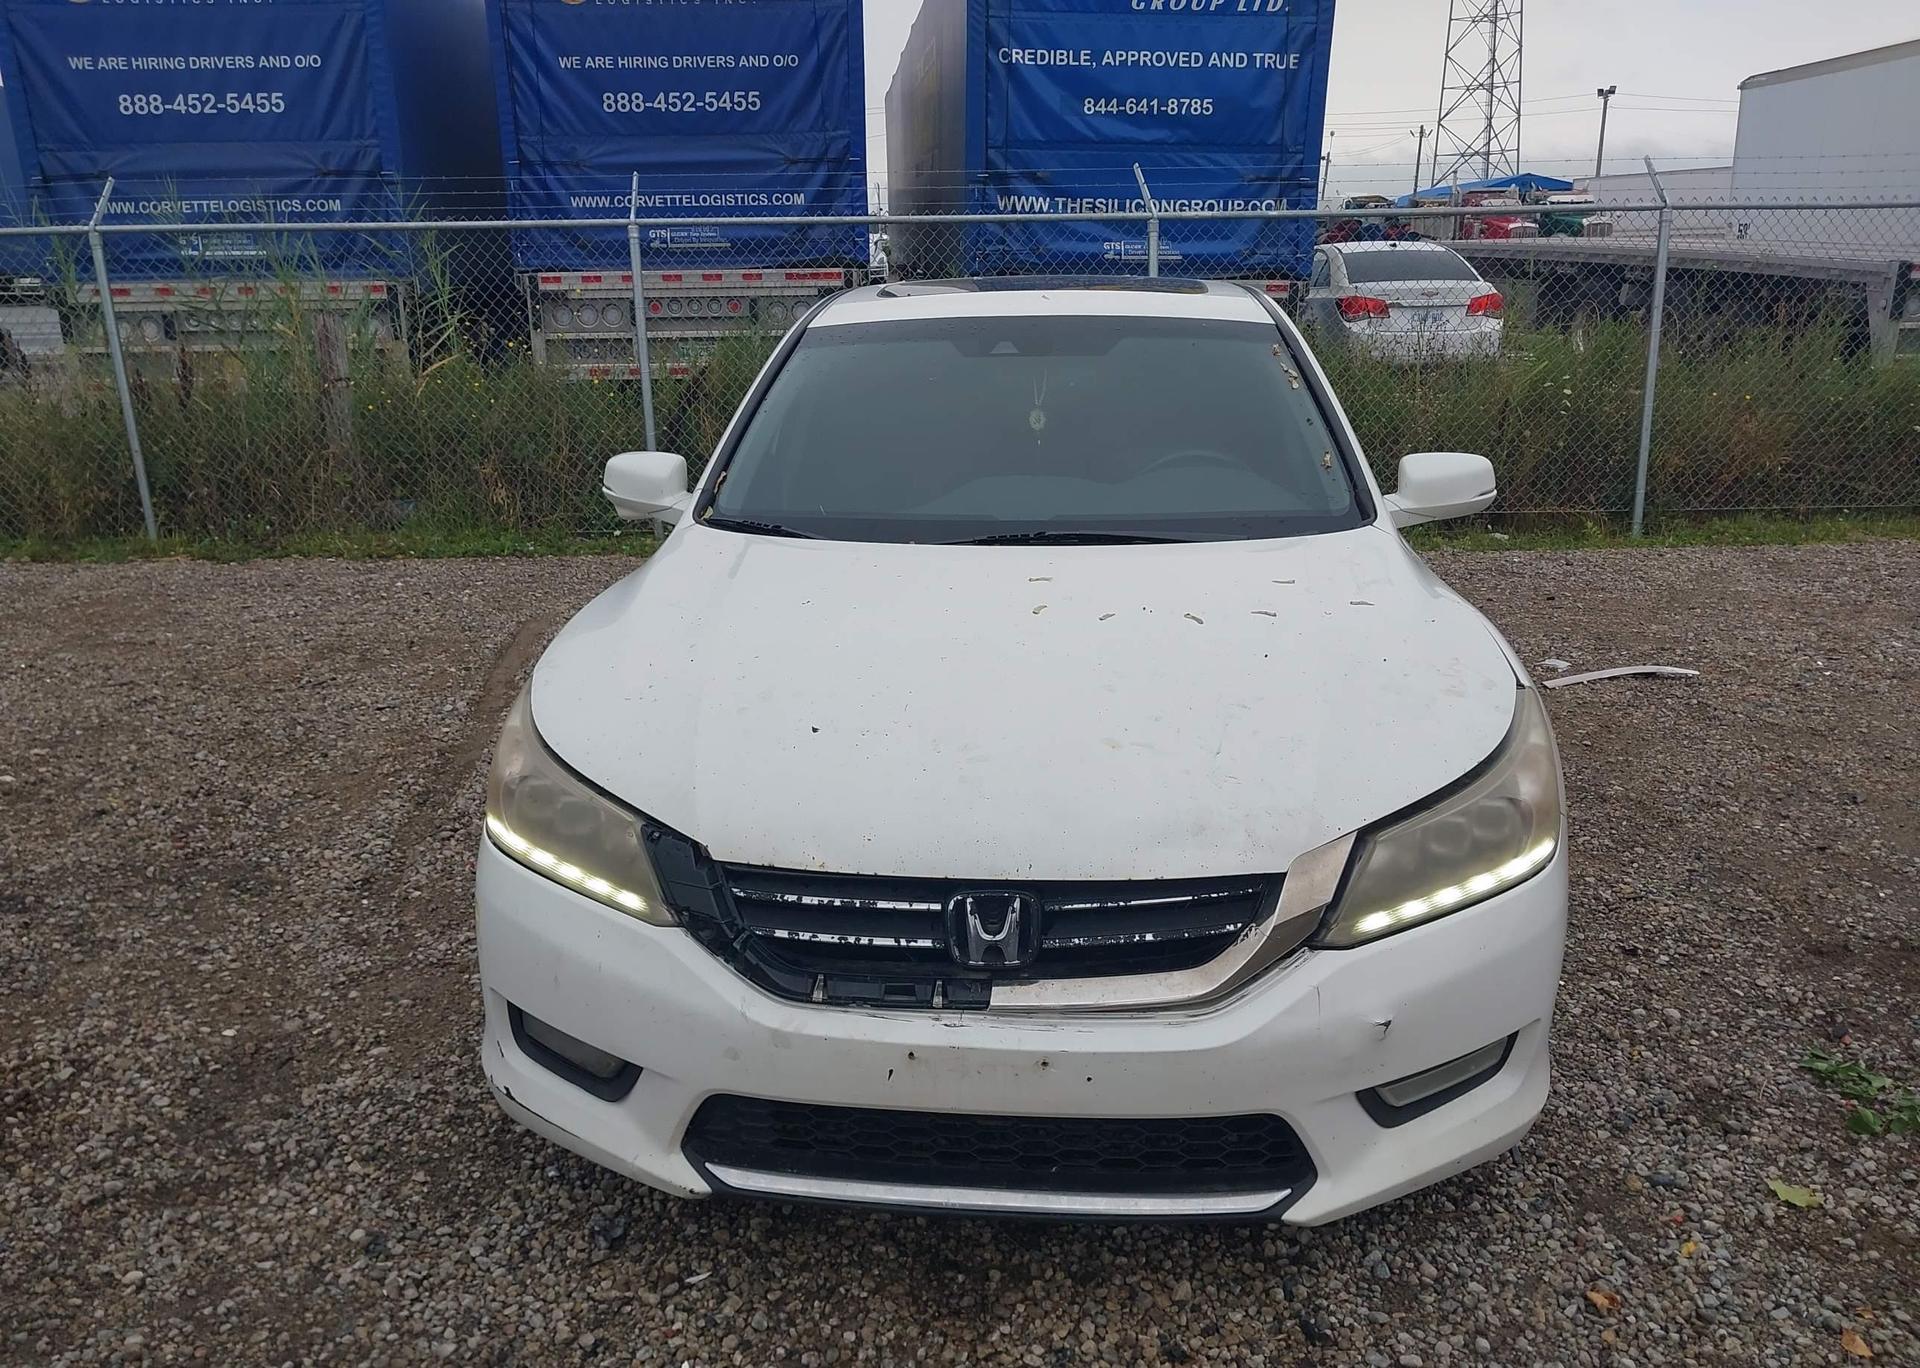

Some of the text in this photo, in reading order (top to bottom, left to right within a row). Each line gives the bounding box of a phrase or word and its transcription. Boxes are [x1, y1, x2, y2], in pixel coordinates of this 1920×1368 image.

[68, 54, 322, 71] WE ARE HIRING DRIVERS AND O/O
[558, 54, 799, 69] WE ARE HIRING DRIVERS AND O/O
[998, 47, 1300, 70] CREDIBLE, APPROVED AND TRUE
[118, 92, 285, 115] 888-452-5455
[602, 91, 761, 113] 888-452-5455
[1083, 98, 1213, 115] 844-641-8785
[570, 193, 805, 208] WWW.CORVETTELOGISTICS.COM
[996, 194, 1288, 213] WWW.THESILICONGROUPCOM
[649, 229, 667, 238] GTS
[1103, 242, 1121, 250] GTS
